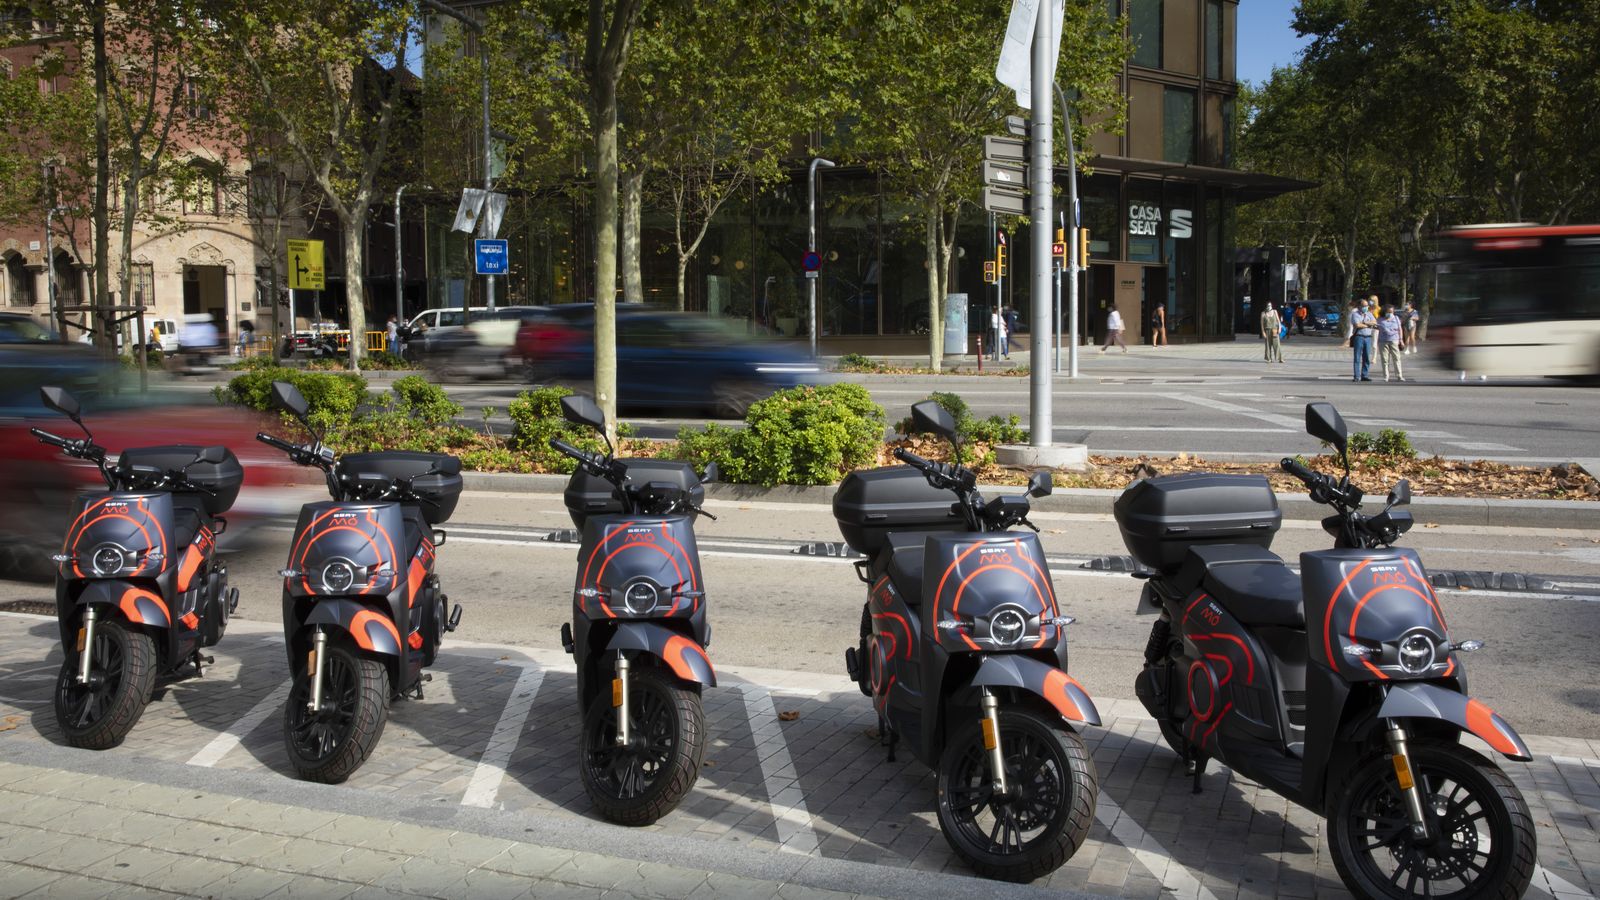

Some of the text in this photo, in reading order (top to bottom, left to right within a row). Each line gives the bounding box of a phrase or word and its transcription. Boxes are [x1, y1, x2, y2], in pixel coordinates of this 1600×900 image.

[1129, 205, 1162, 221] CASA
[1129, 220, 1158, 236] SEAT
[485, 260, 499, 269] taxi
